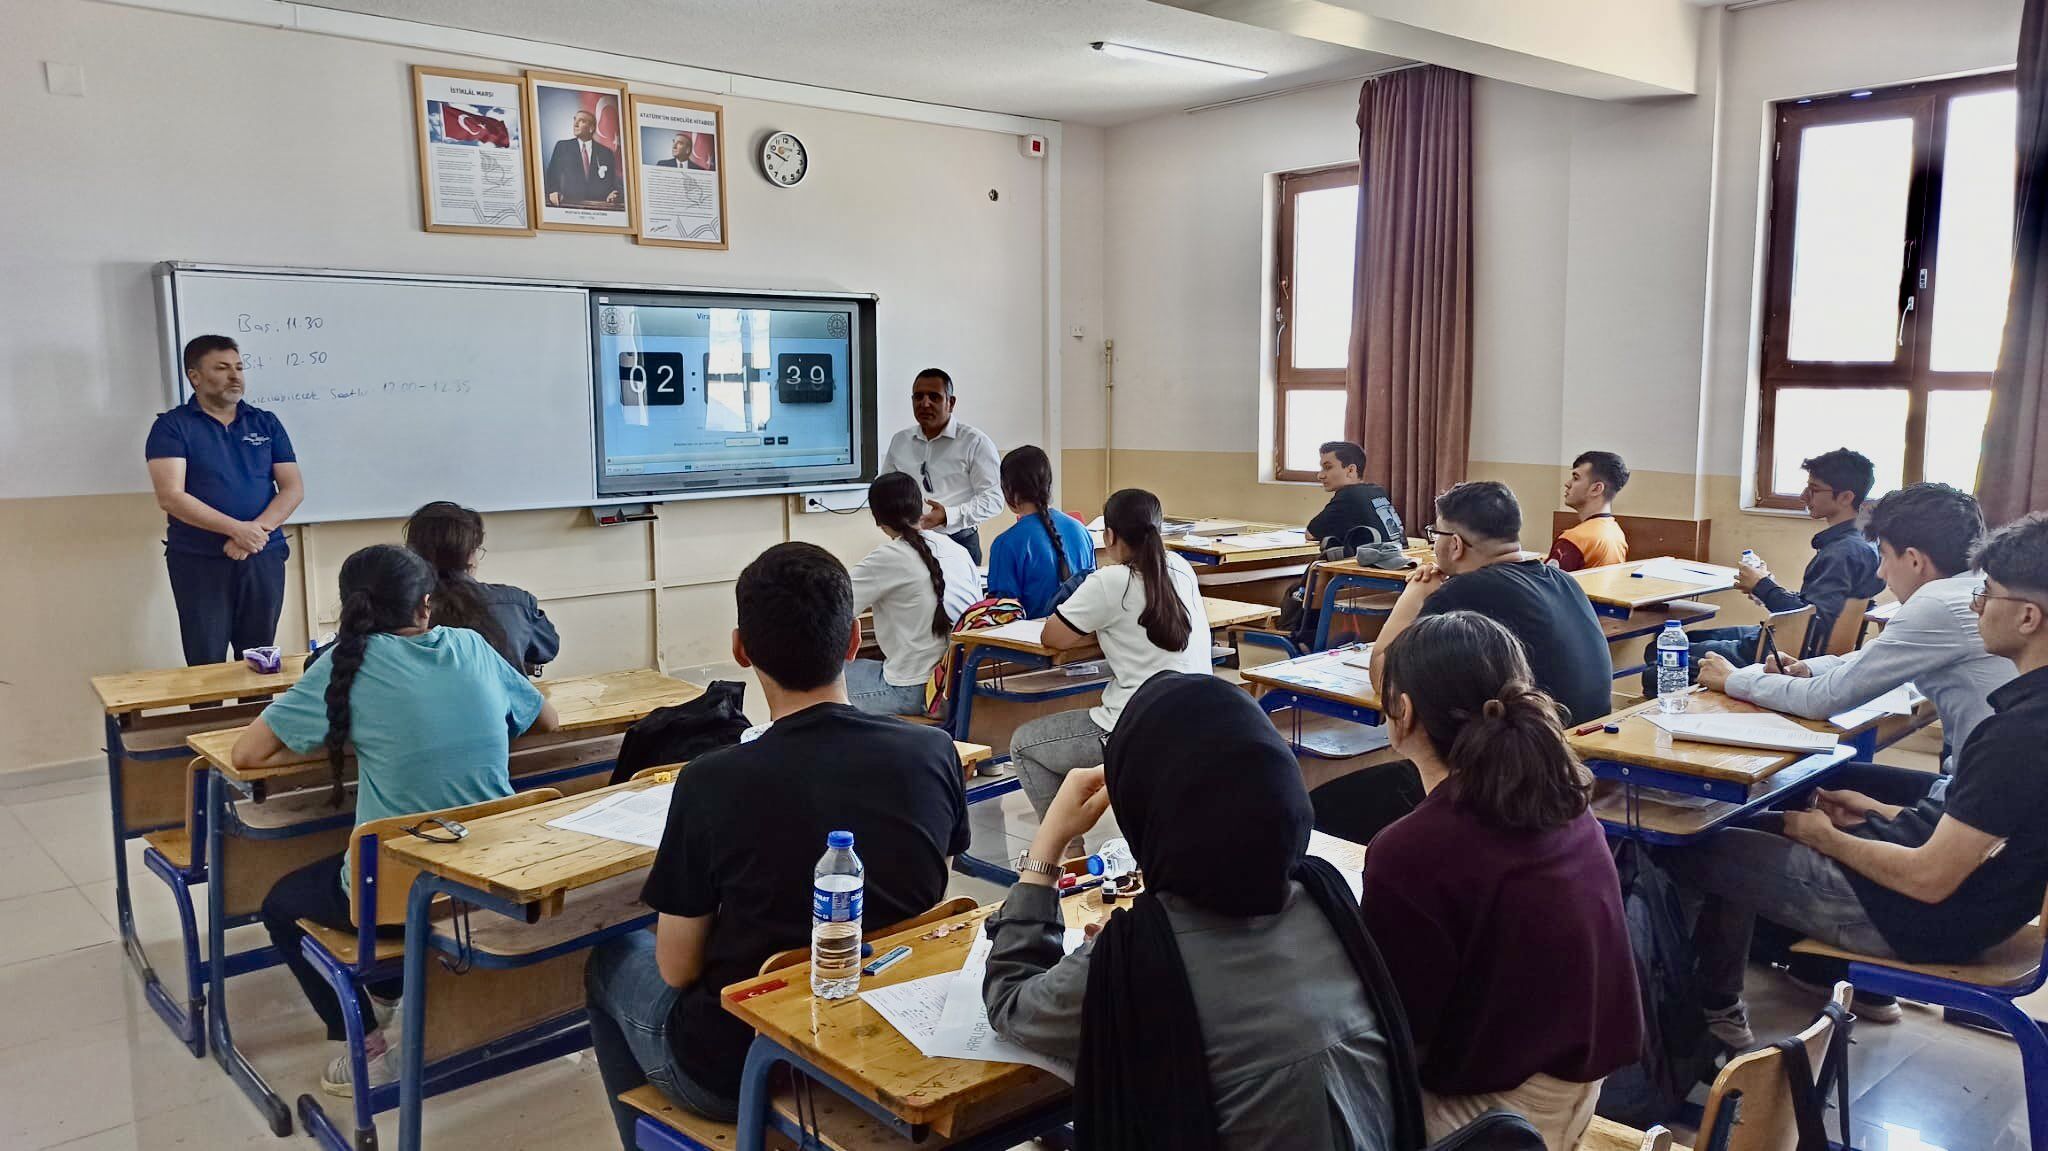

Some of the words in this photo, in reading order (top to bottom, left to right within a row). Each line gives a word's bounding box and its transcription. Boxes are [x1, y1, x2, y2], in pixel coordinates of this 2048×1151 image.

[286, 351, 328, 367] 12.50
[630, 364, 675, 393] 02
[786, 365, 825, 389] 39
